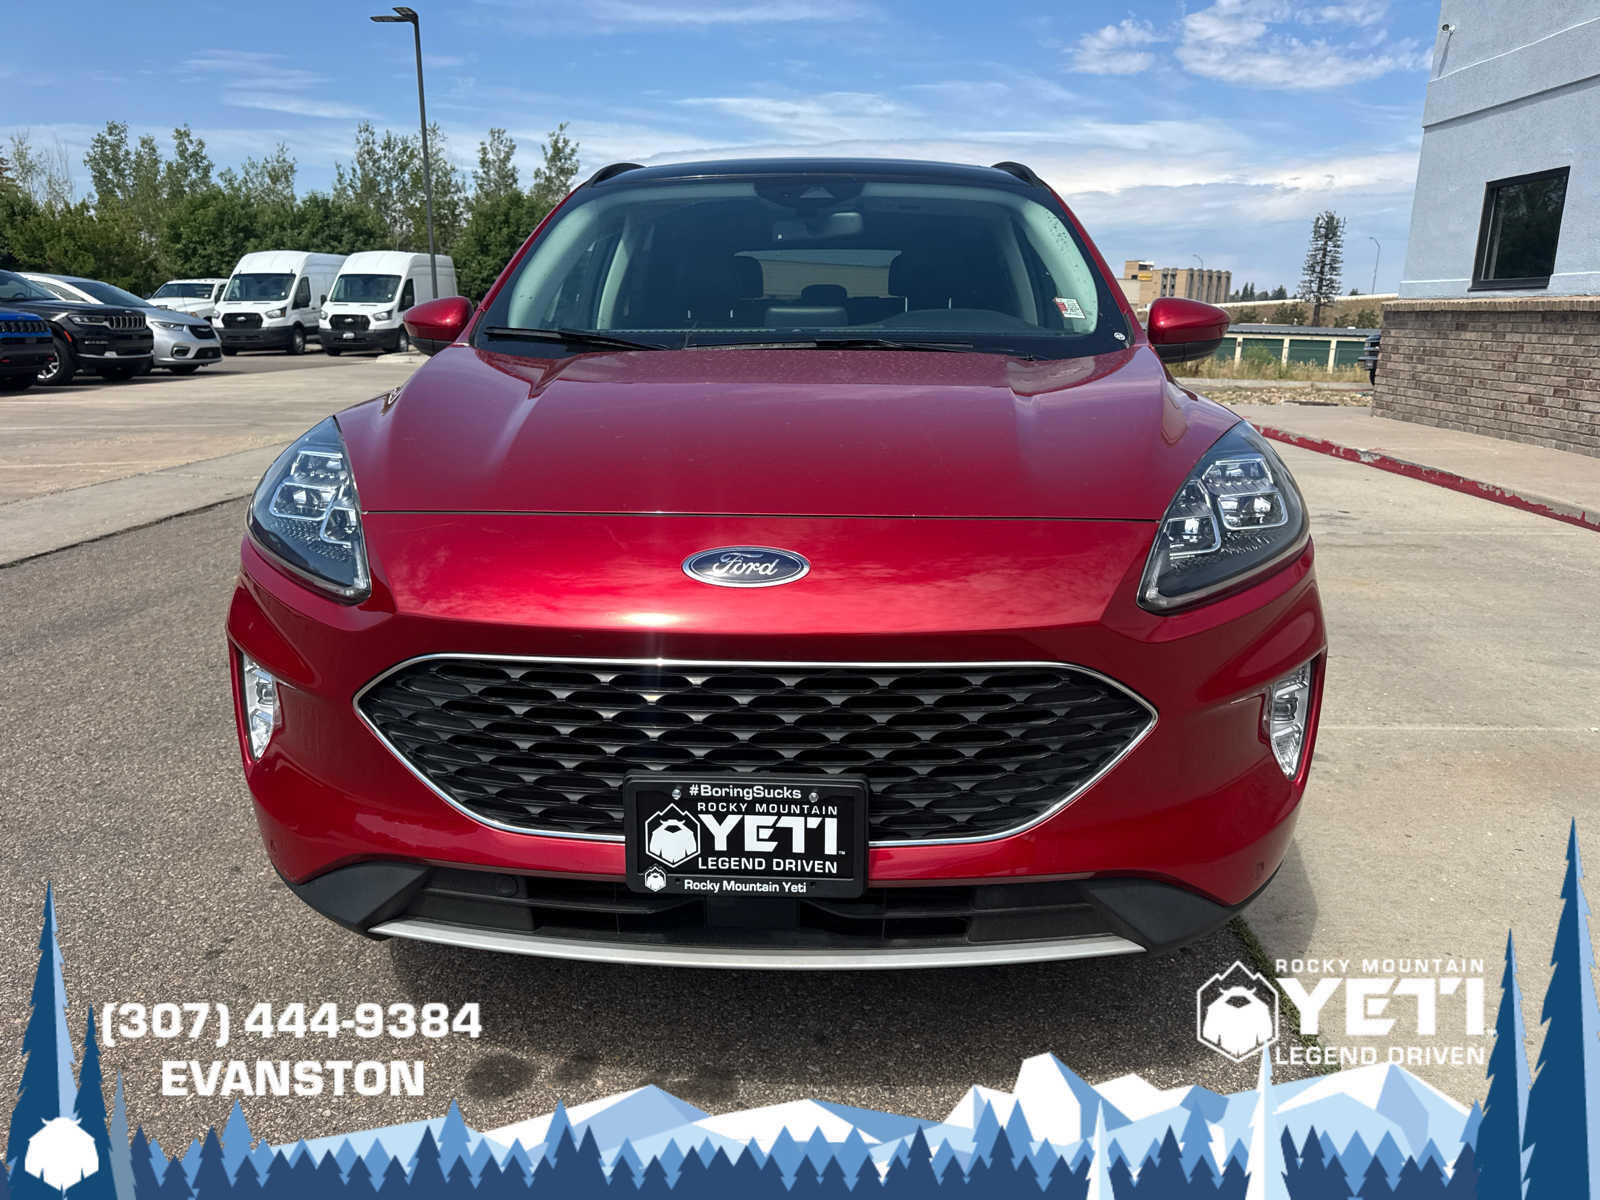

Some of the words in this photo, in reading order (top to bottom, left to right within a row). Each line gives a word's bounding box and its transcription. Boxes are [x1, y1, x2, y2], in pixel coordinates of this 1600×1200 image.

[712, 552, 780, 577] Ford
[689, 784, 802, 800] #BoringSucks
[697, 802, 748, 812] ROCKY
[755, 803, 838, 815] MOUNTAIN
[698, 814, 838, 855] YETI
[698, 857, 766, 871] LEGEND
[772, 858, 838, 874] DRIVEN
[684, 879, 721, 893] Rocky
[722, 880, 781, 893] Mountain
[782, 881, 807, 893] Yeti
